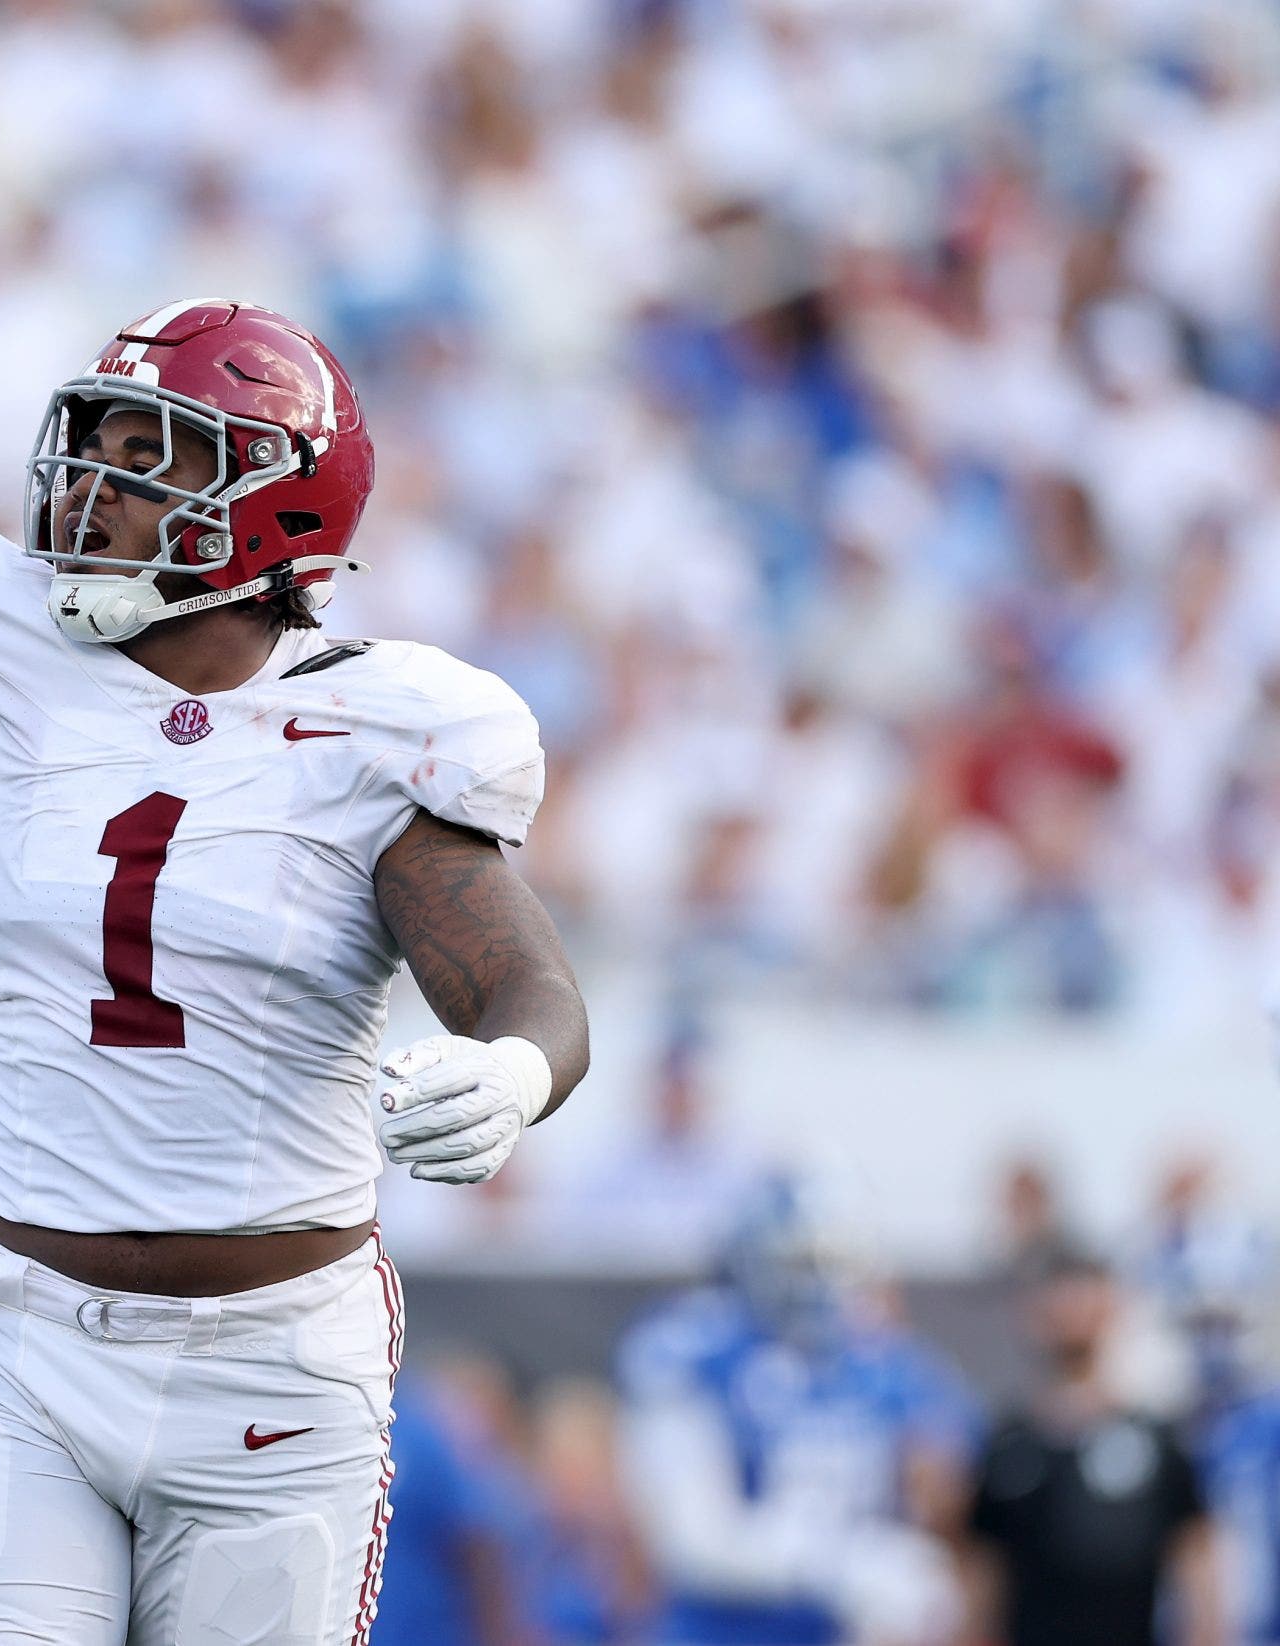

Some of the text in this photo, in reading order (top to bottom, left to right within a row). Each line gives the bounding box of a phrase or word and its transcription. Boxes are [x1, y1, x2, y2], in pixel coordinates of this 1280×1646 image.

[96, 357, 137, 377] BAMA
[61, 586, 80, 606] A
[178, 581, 261, 613] CRIMSON TIDE
[173, 701, 207, 734] SEC
[165, 726, 206, 744] GRADUATE
[88, 790, 189, 1049] 1
